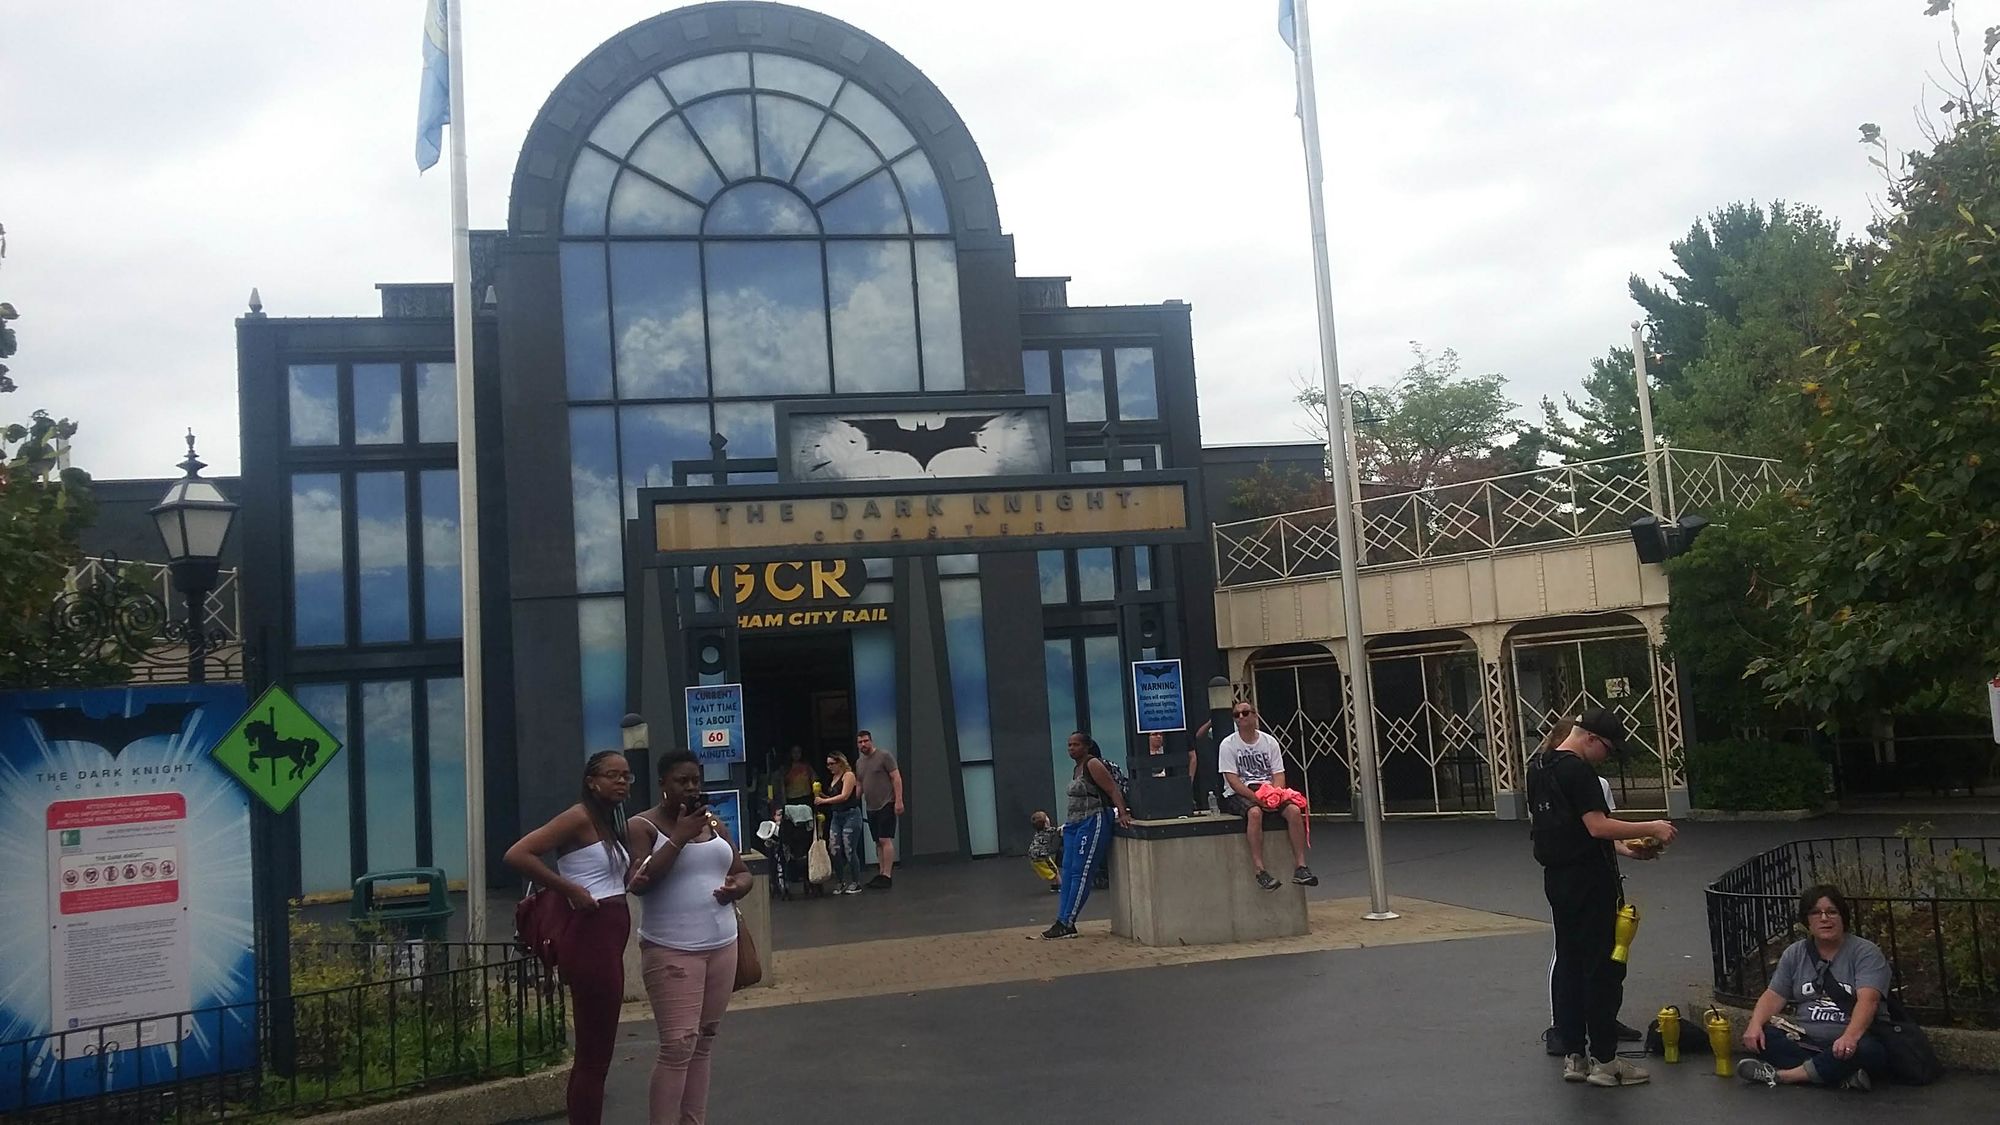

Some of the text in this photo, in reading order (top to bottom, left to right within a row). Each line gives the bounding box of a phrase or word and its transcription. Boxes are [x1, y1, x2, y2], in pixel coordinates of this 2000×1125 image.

[714, 502, 795, 525] THE
[830, 495, 944, 520] DARK
[814, 521, 1045, 542] COASTER
[711, 559, 851, 604] GCR
[789, 610, 838, 626] CITY
[842, 608, 888, 623] RAIL
[1141, 681, 1177, 691] WARNING:
[695, 690, 732, 700] CURRENT
[692, 702, 737, 713] WAIT TIME
[695, 715, 735, 726] IS ABOUT
[708, 732, 724, 742] 60
[699, 749, 736, 759] MINUTES
[36, 763, 193, 782] THE DARK KNIGHT
[55, 777, 176, 791] COASTER
